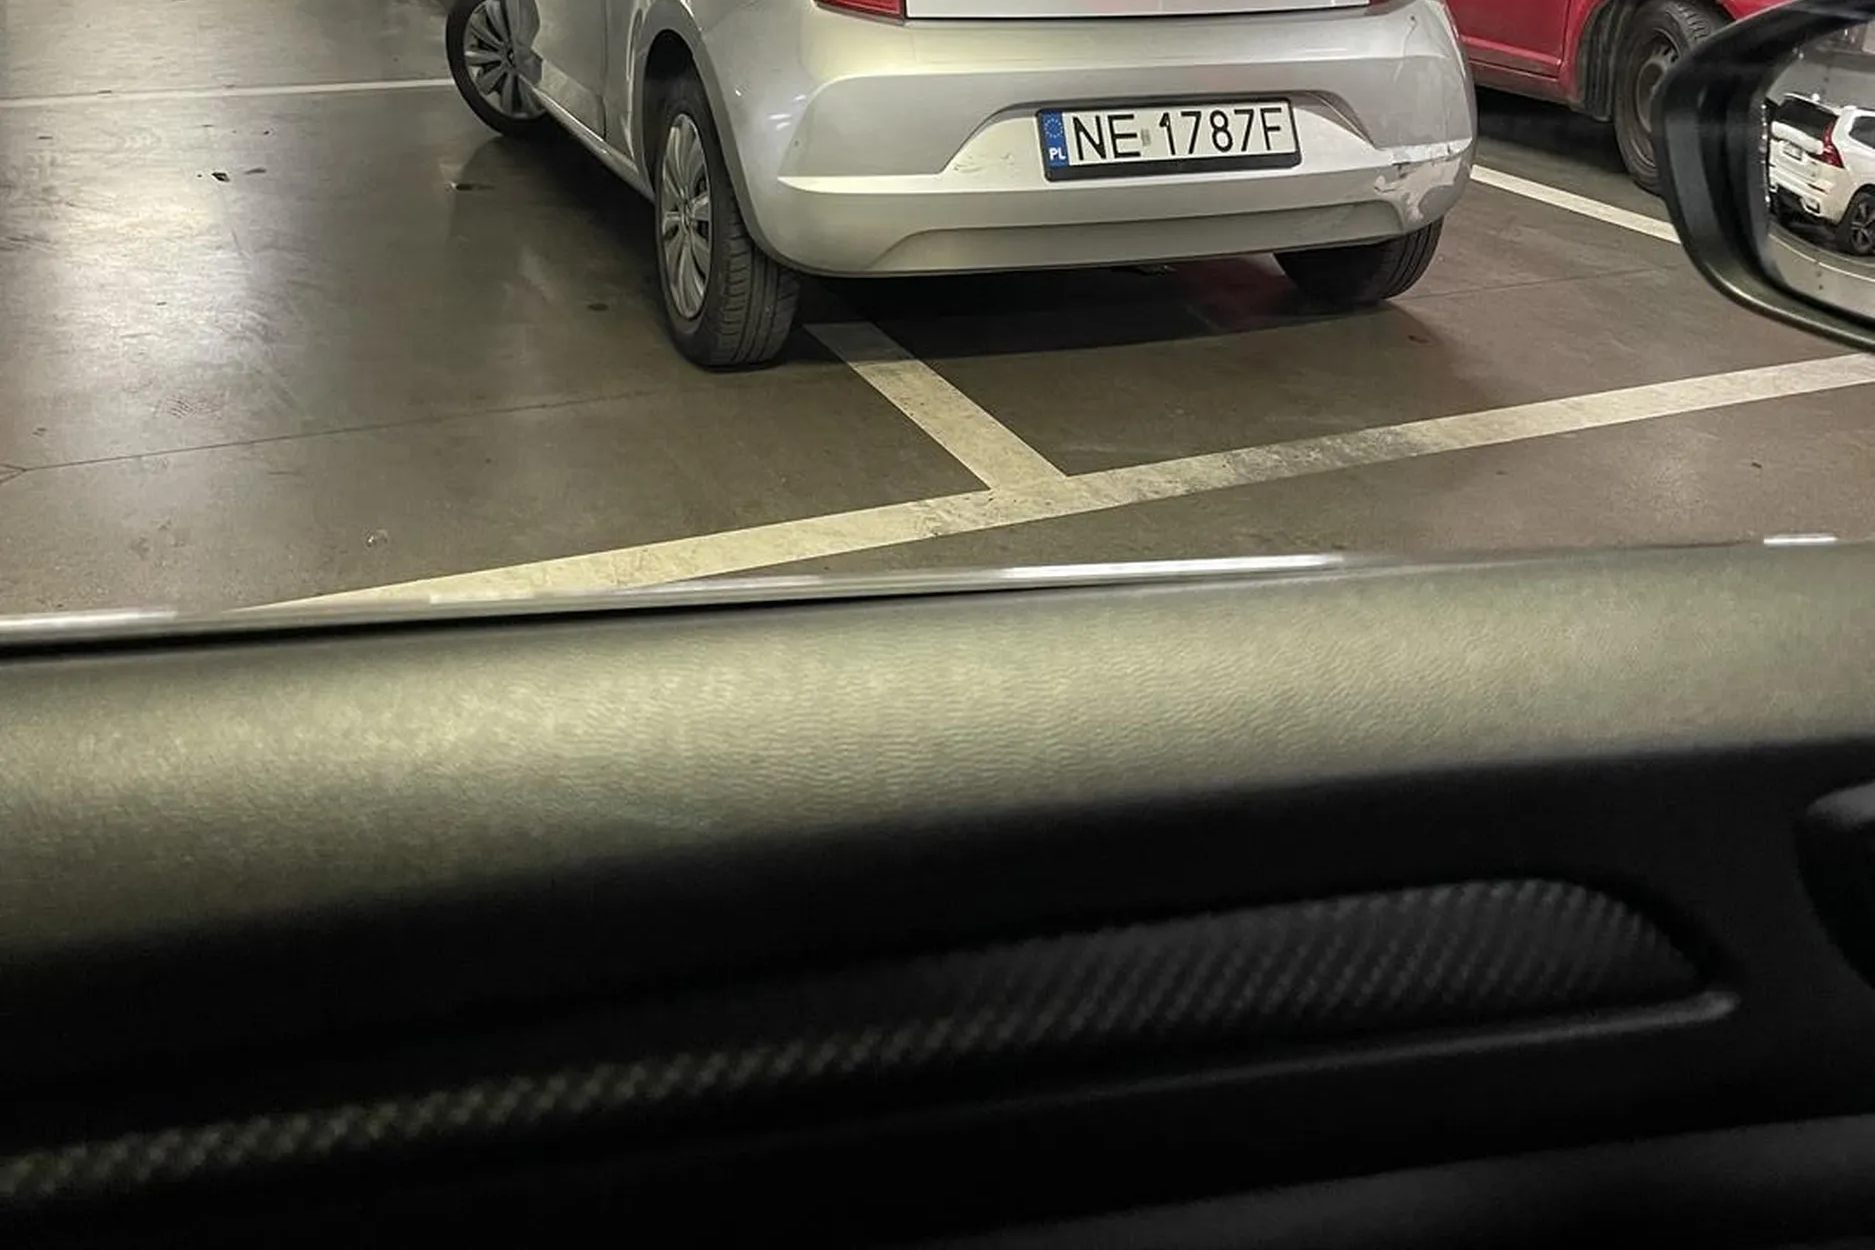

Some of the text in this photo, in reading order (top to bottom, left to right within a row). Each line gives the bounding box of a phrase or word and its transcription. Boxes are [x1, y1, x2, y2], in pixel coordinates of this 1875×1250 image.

[1072, 107, 1282, 160] NE 1787F
[1049, 147, 1066, 160] PL
